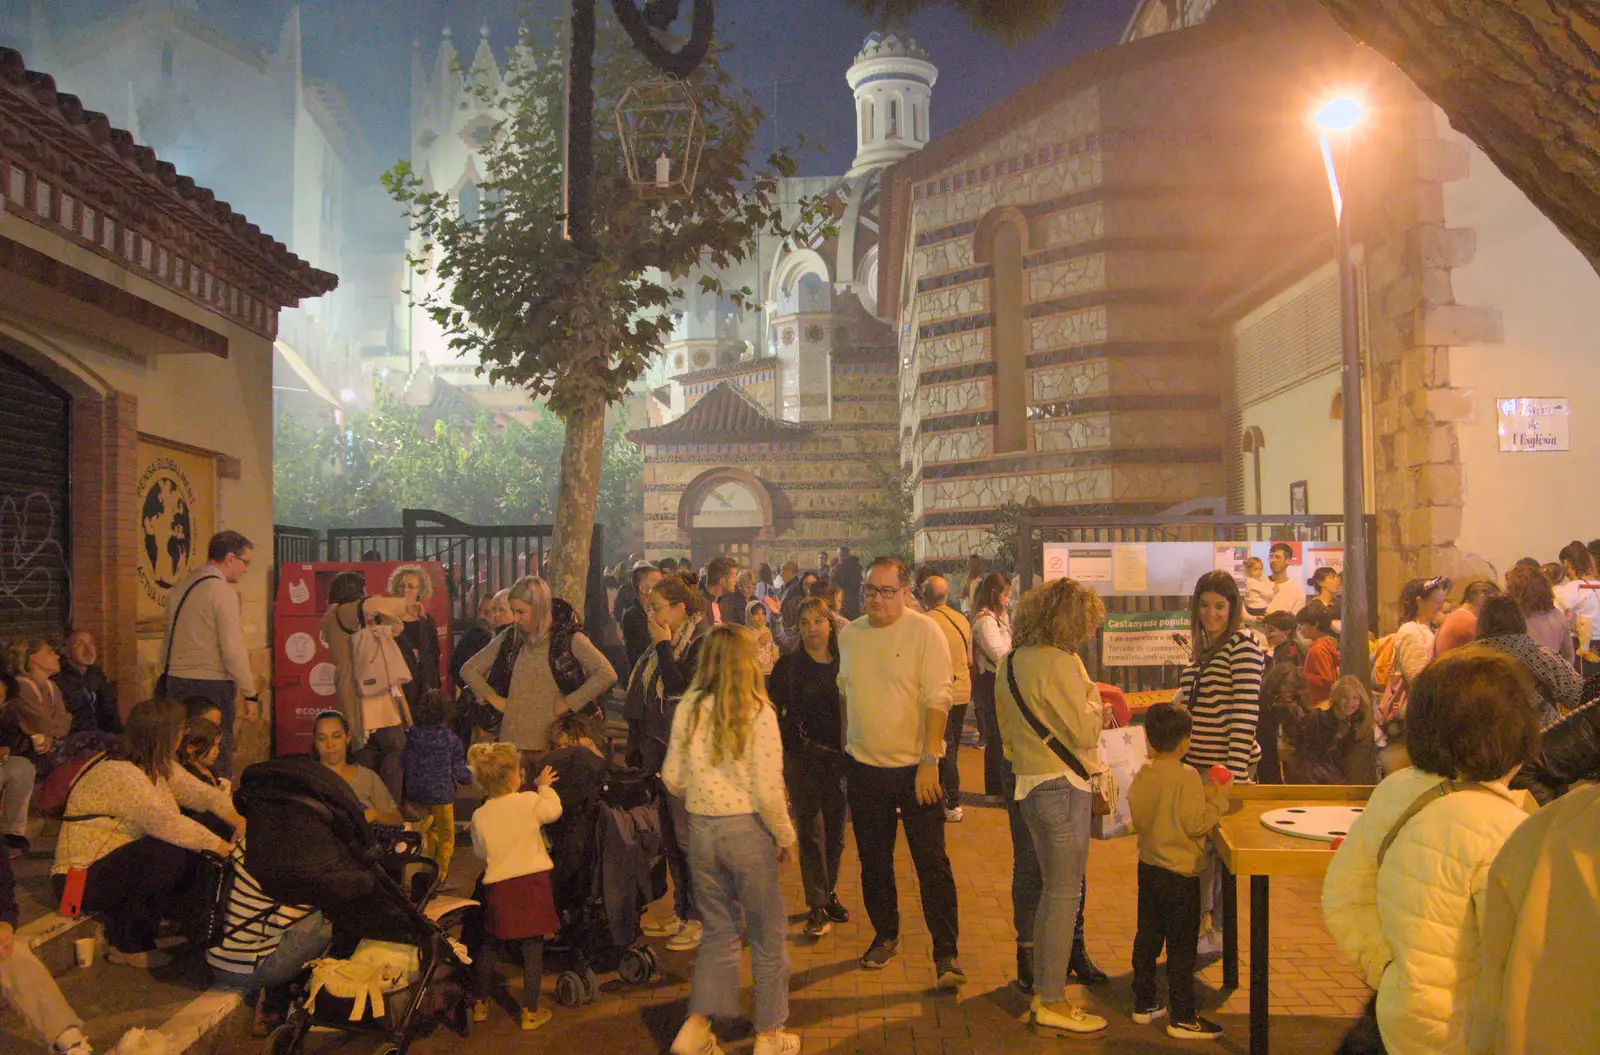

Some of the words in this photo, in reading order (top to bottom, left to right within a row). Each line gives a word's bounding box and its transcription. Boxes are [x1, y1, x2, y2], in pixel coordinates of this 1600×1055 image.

[1108, 619, 1157, 629] Castanyada
[1124, 634, 1158, 642] novembre
[295, 705, 332, 716] ecos
